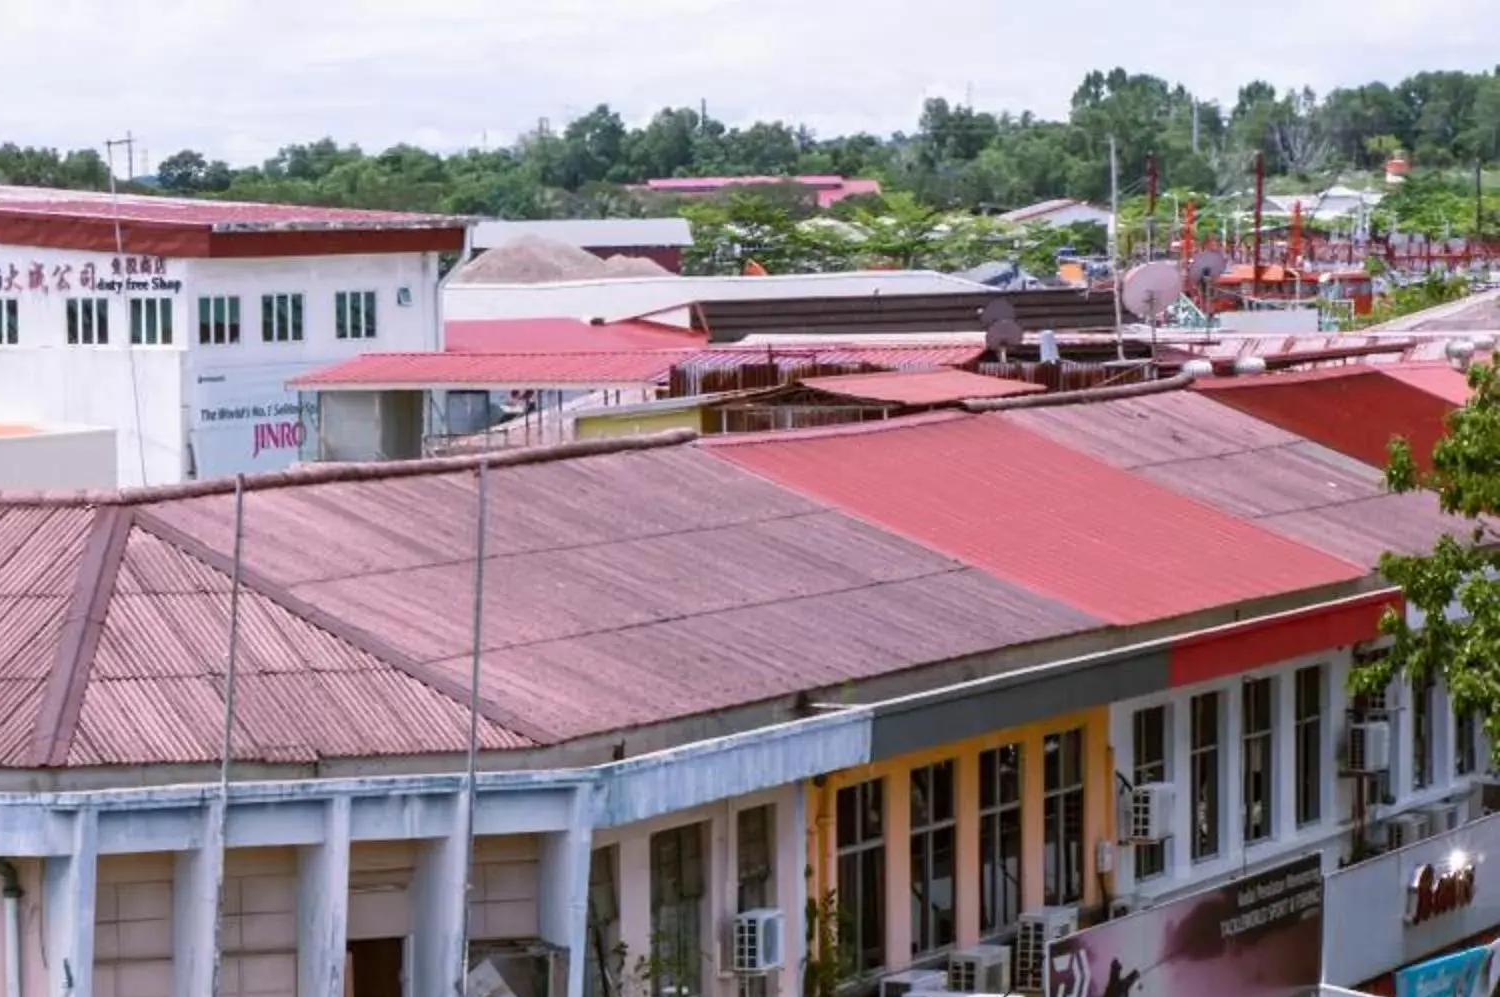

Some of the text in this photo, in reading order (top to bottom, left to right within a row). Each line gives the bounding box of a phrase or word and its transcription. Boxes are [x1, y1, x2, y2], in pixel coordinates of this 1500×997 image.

[96, 276, 183, 294] duty free Shop
[252, 420, 307, 459] JINRO
